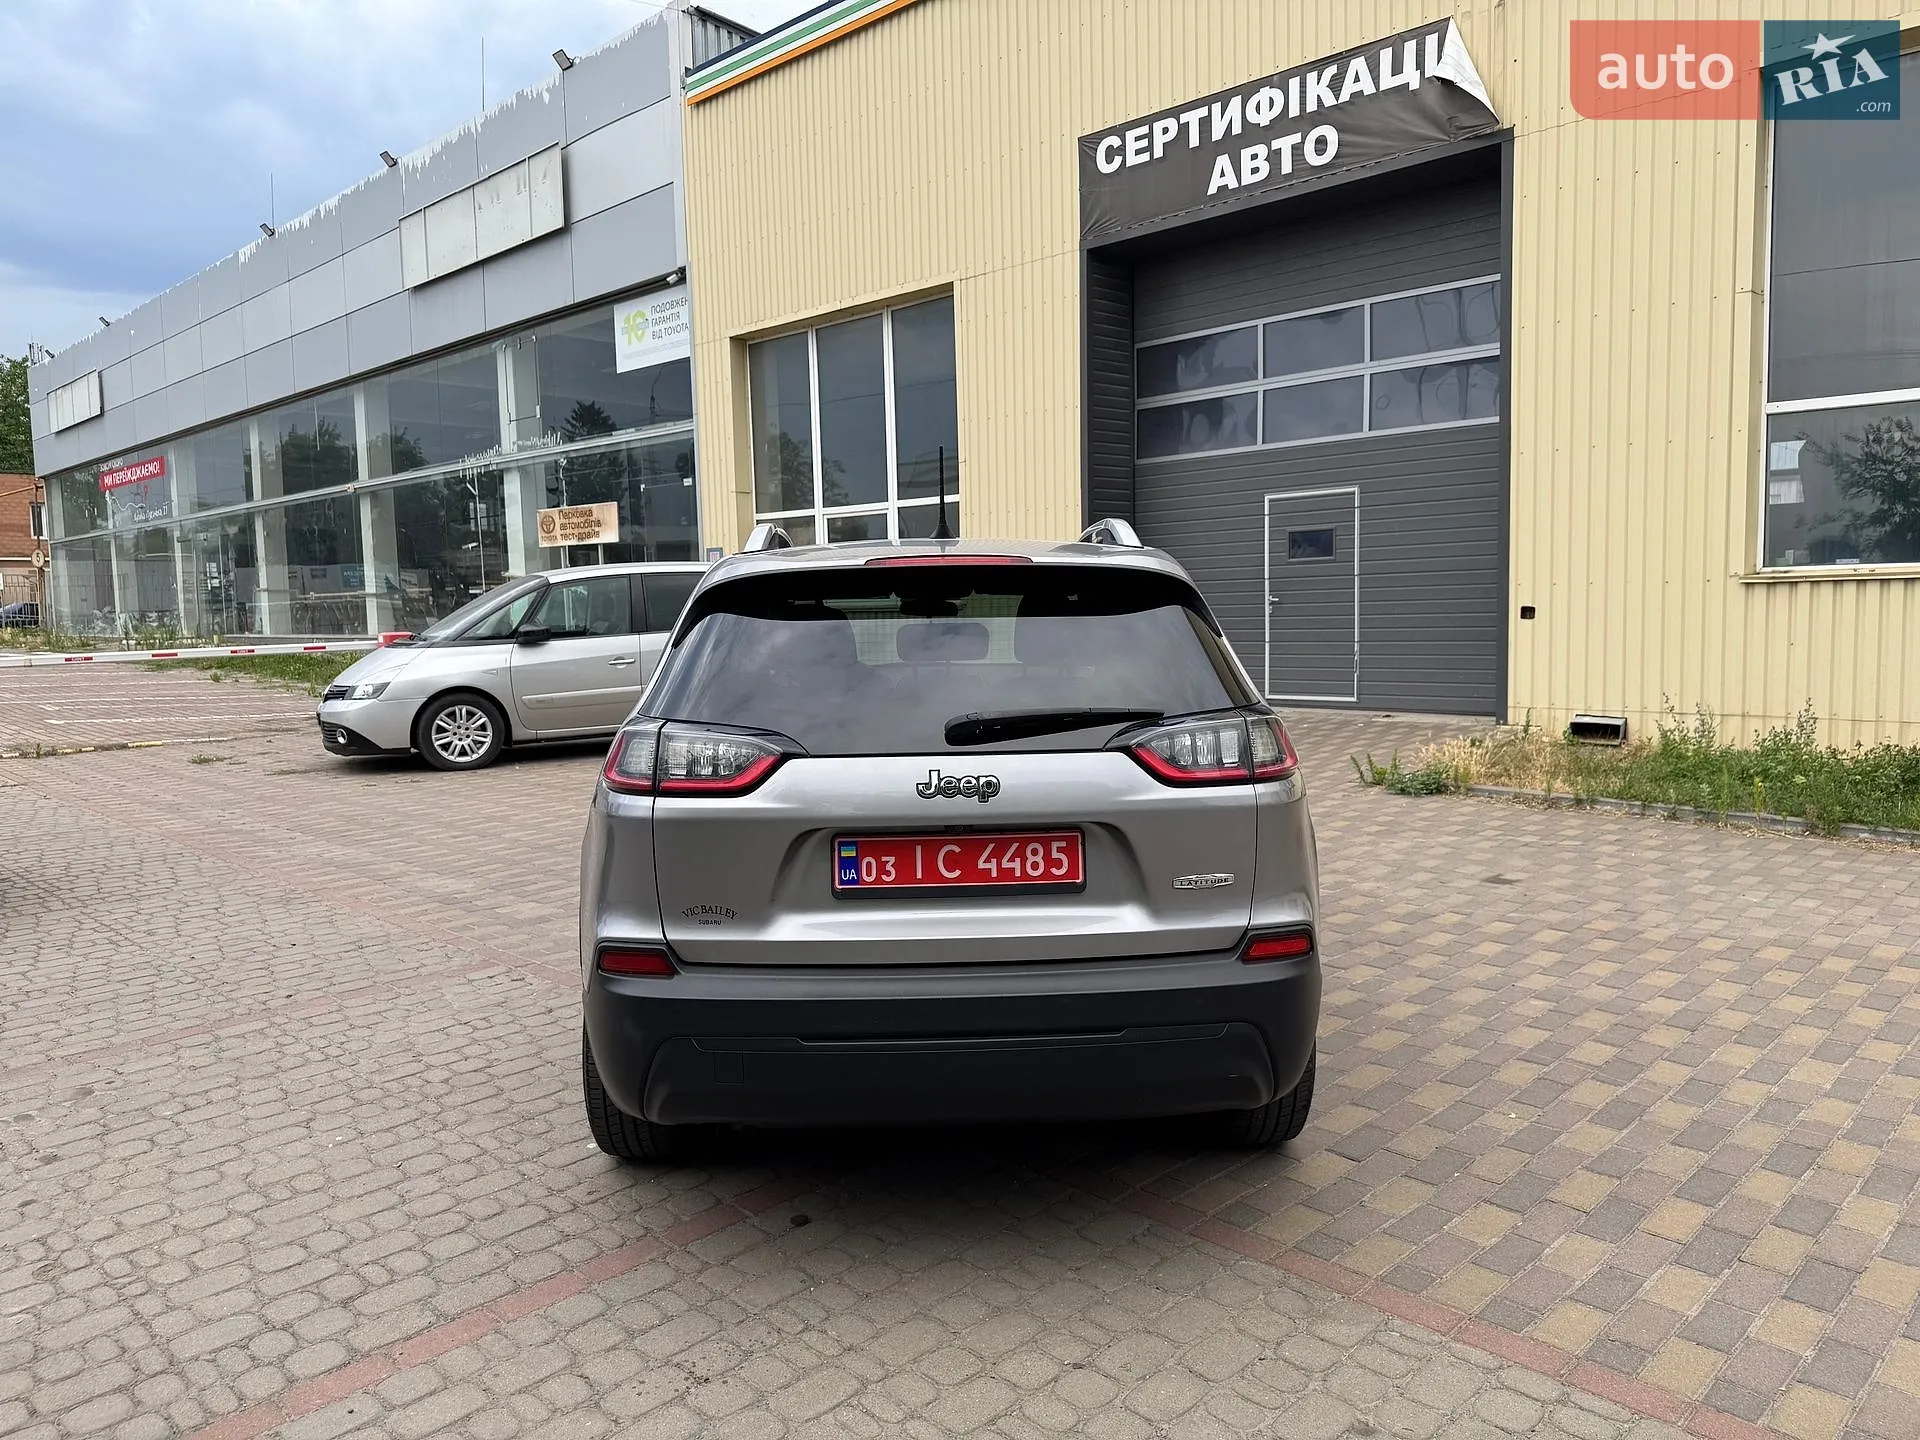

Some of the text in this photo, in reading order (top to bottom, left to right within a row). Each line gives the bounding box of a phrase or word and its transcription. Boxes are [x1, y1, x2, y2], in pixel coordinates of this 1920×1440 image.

[1206, 124, 1339, 196] АВТО
[651, 311, 681, 328] ГАРАНТІЯ
[652, 329, 663, 340] ВІД
[560, 518, 602, 531] автомобілів
[560, 530, 600, 541] тест-драйв
[916, 769, 1000, 803] Jeep
[861, 856, 896, 882] 03
[977, 841, 1069, 878] 4485
[841, 869, 857, 880] UA
[1180, 877, 1229, 887] LATITUDE
[682, 904, 738, 920] VIC BAILEY
